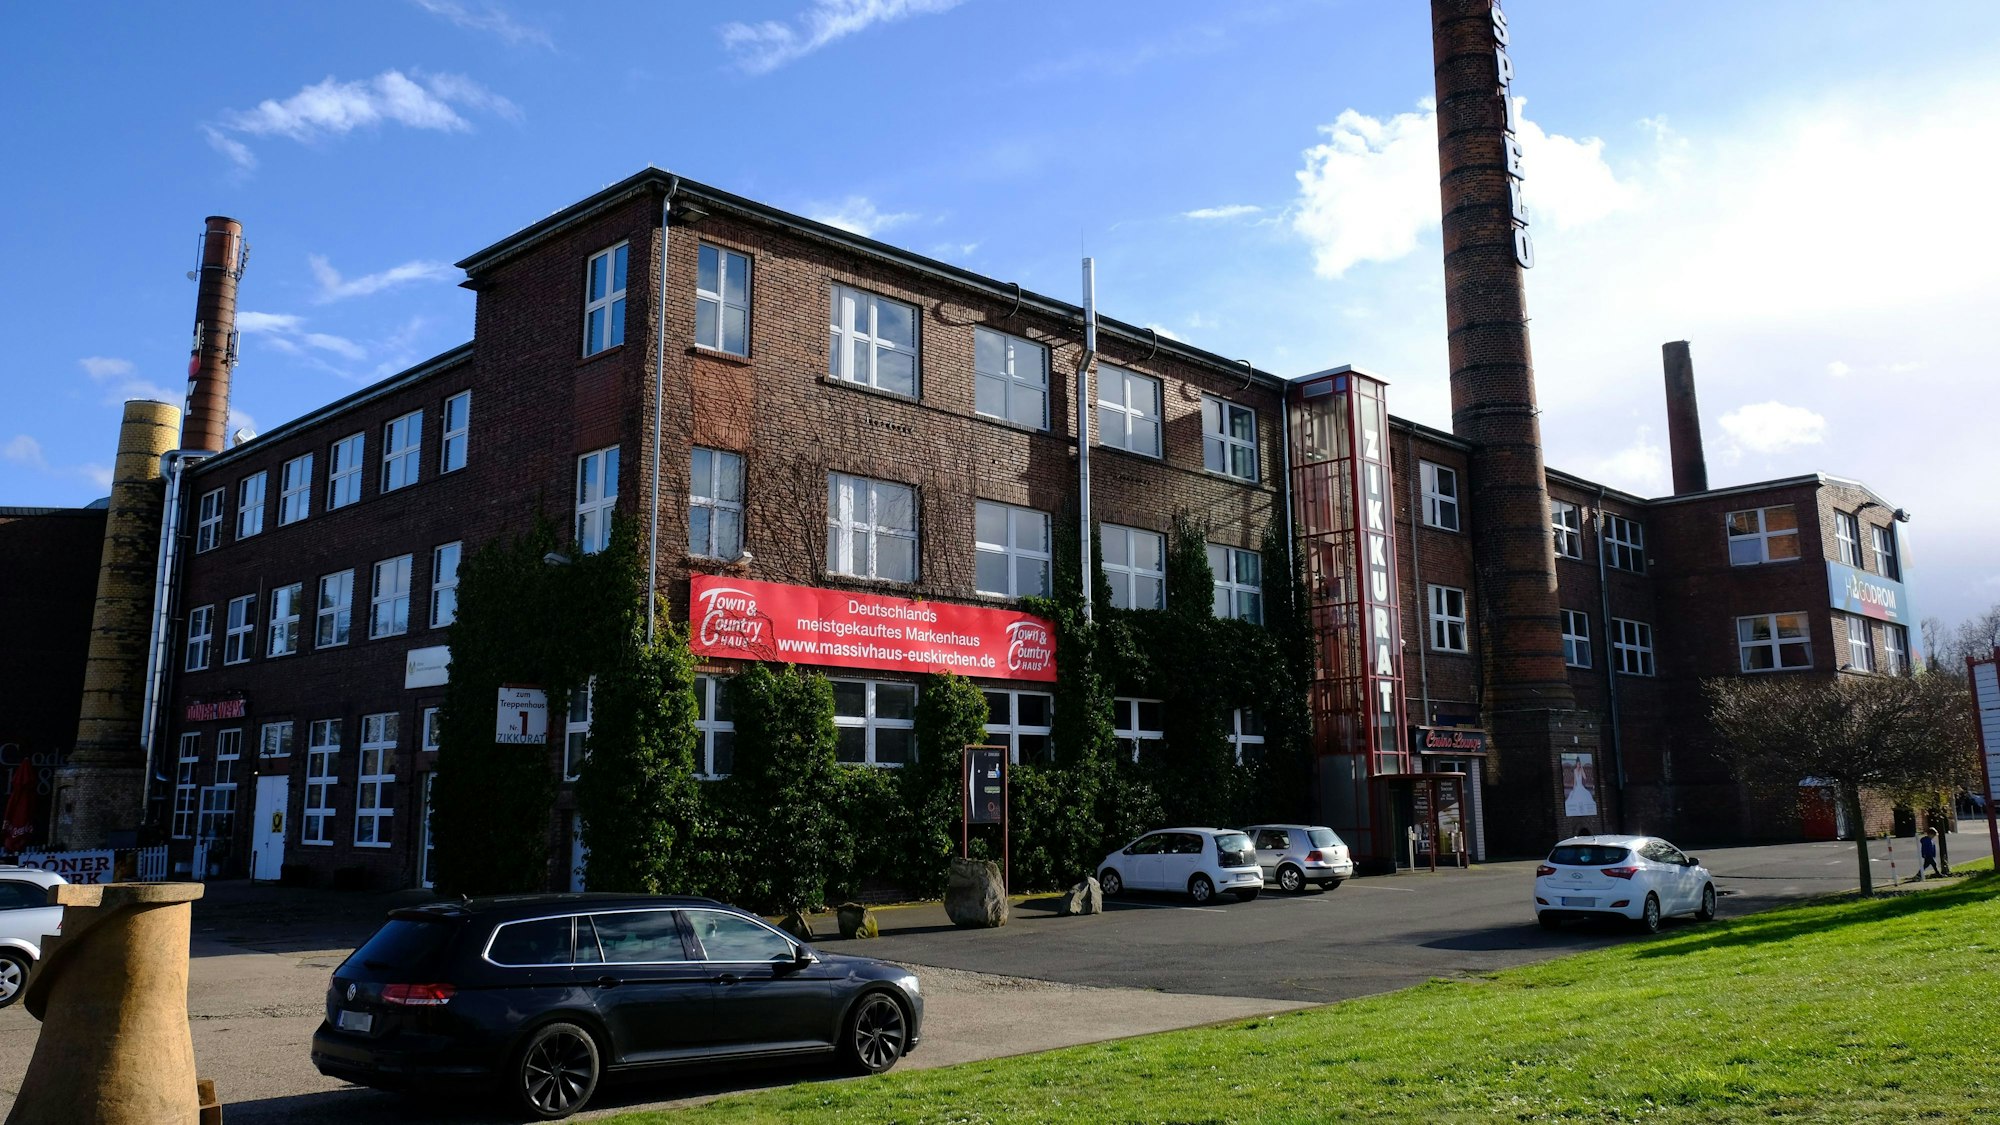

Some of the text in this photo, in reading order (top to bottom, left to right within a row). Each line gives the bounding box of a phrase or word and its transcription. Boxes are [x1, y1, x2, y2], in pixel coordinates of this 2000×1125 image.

[1489, 6, 1535, 269] SPIELO
[1364, 429, 1394, 713] ZIKKURAT
[699, 587, 758, 617] Town &
[848, 600, 937, 623] Deutschlands
[700, 609, 763, 647] Country
[797, 618, 981, 647] meistgekauftes Markenhaus
[1005, 621, 1047, 645] Town &
[720, 635, 749, 648] HAUS
[777, 638, 996, 669] www.massivhaus-euskirchen.de
[1007, 639, 1051, 671] Country
[1022, 661, 1043, 671] HAUS
[500, 699, 545, 709] Treppenhaus
[519, 711, 529, 736] 1
[497, 733, 545, 744] ZIKKURAT
[1425, 729, 1482, 753] Casino Lounge
